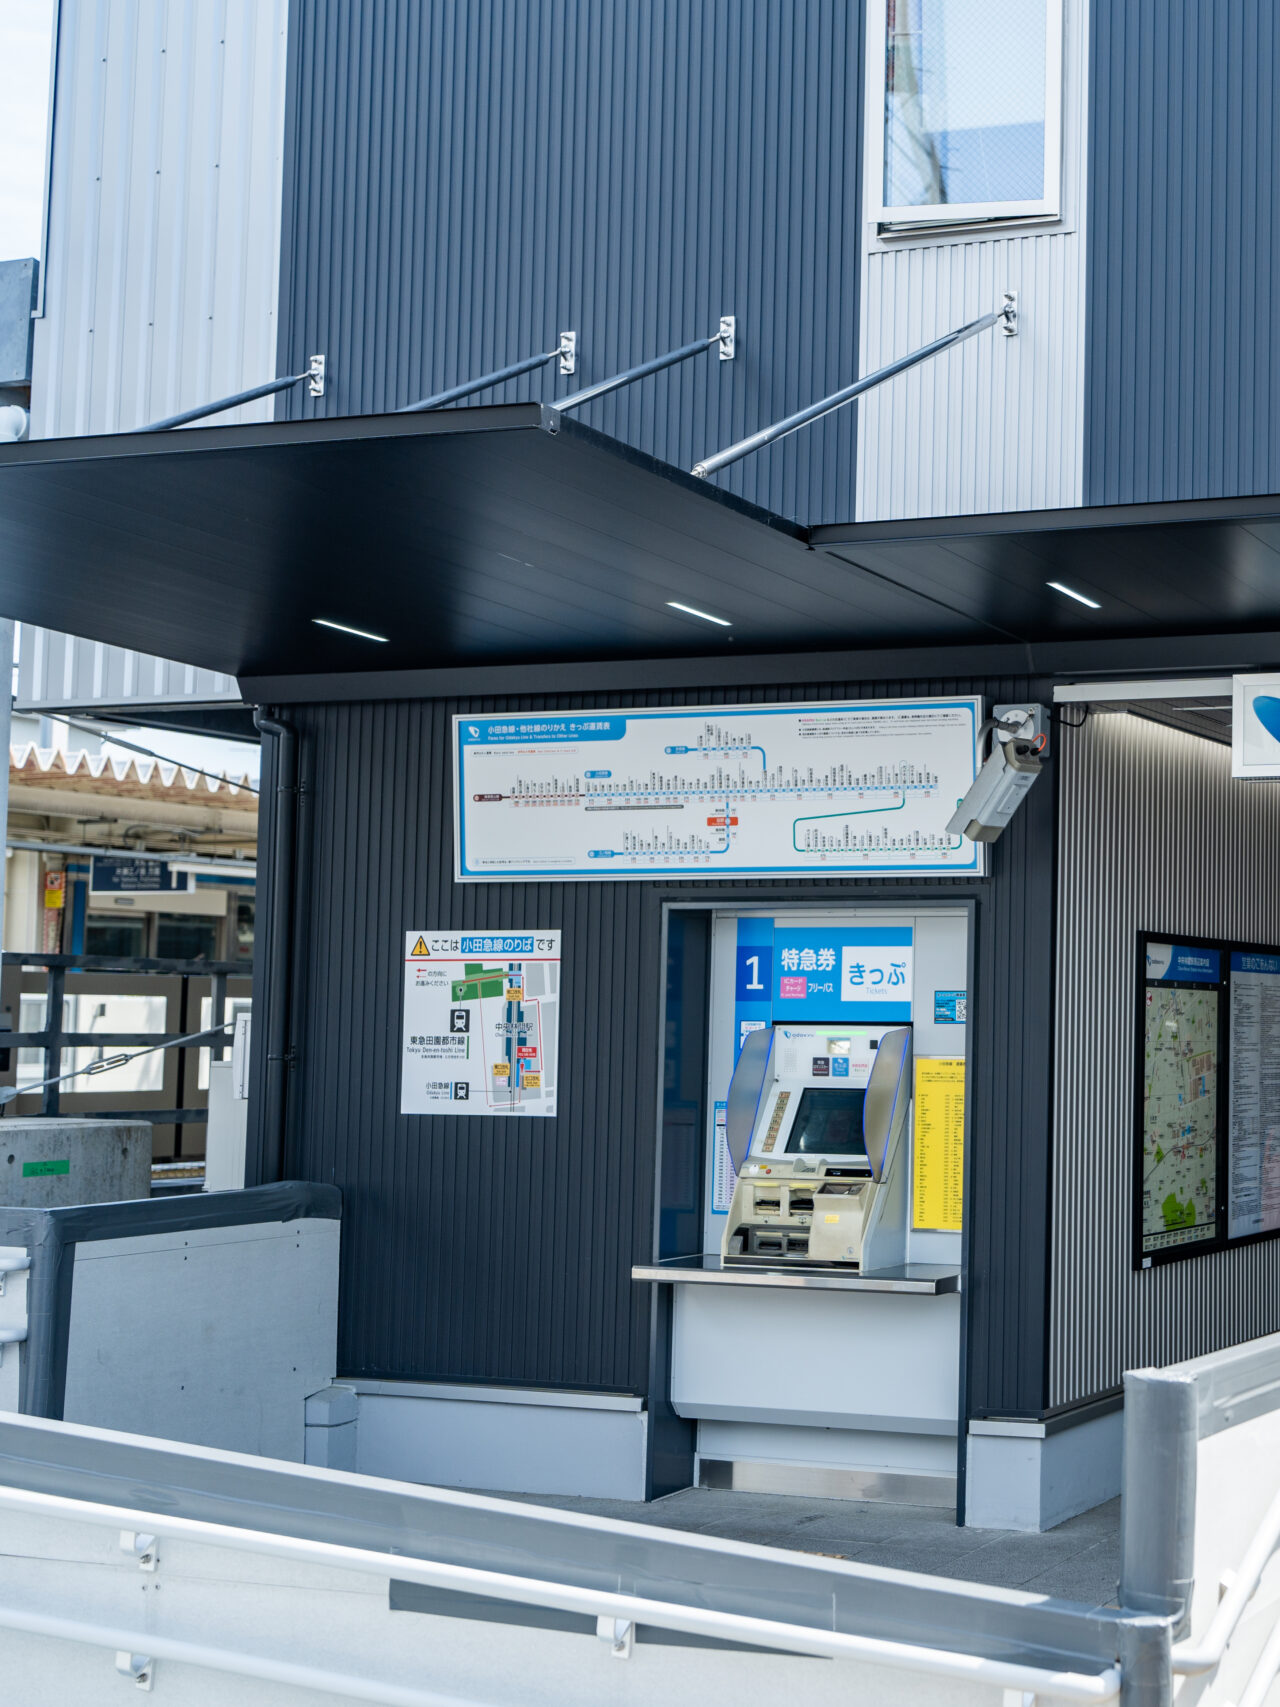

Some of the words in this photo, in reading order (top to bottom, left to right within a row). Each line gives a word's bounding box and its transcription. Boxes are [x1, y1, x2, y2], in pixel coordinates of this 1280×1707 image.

[431, 939, 460, 952] ここは
[462, 937, 533, 953] 小田急線のりば
[535, 938, 556, 951] です
[745, 955, 764, 990] 1
[781, 948, 836, 971] 特急券
[848, 962, 907, 986] きっぷ
[808, 982, 834, 993] フリーパス
[410, 1036, 465, 1046] 東急田園都市線
[426, 1081, 450, 1090] 小田急線
